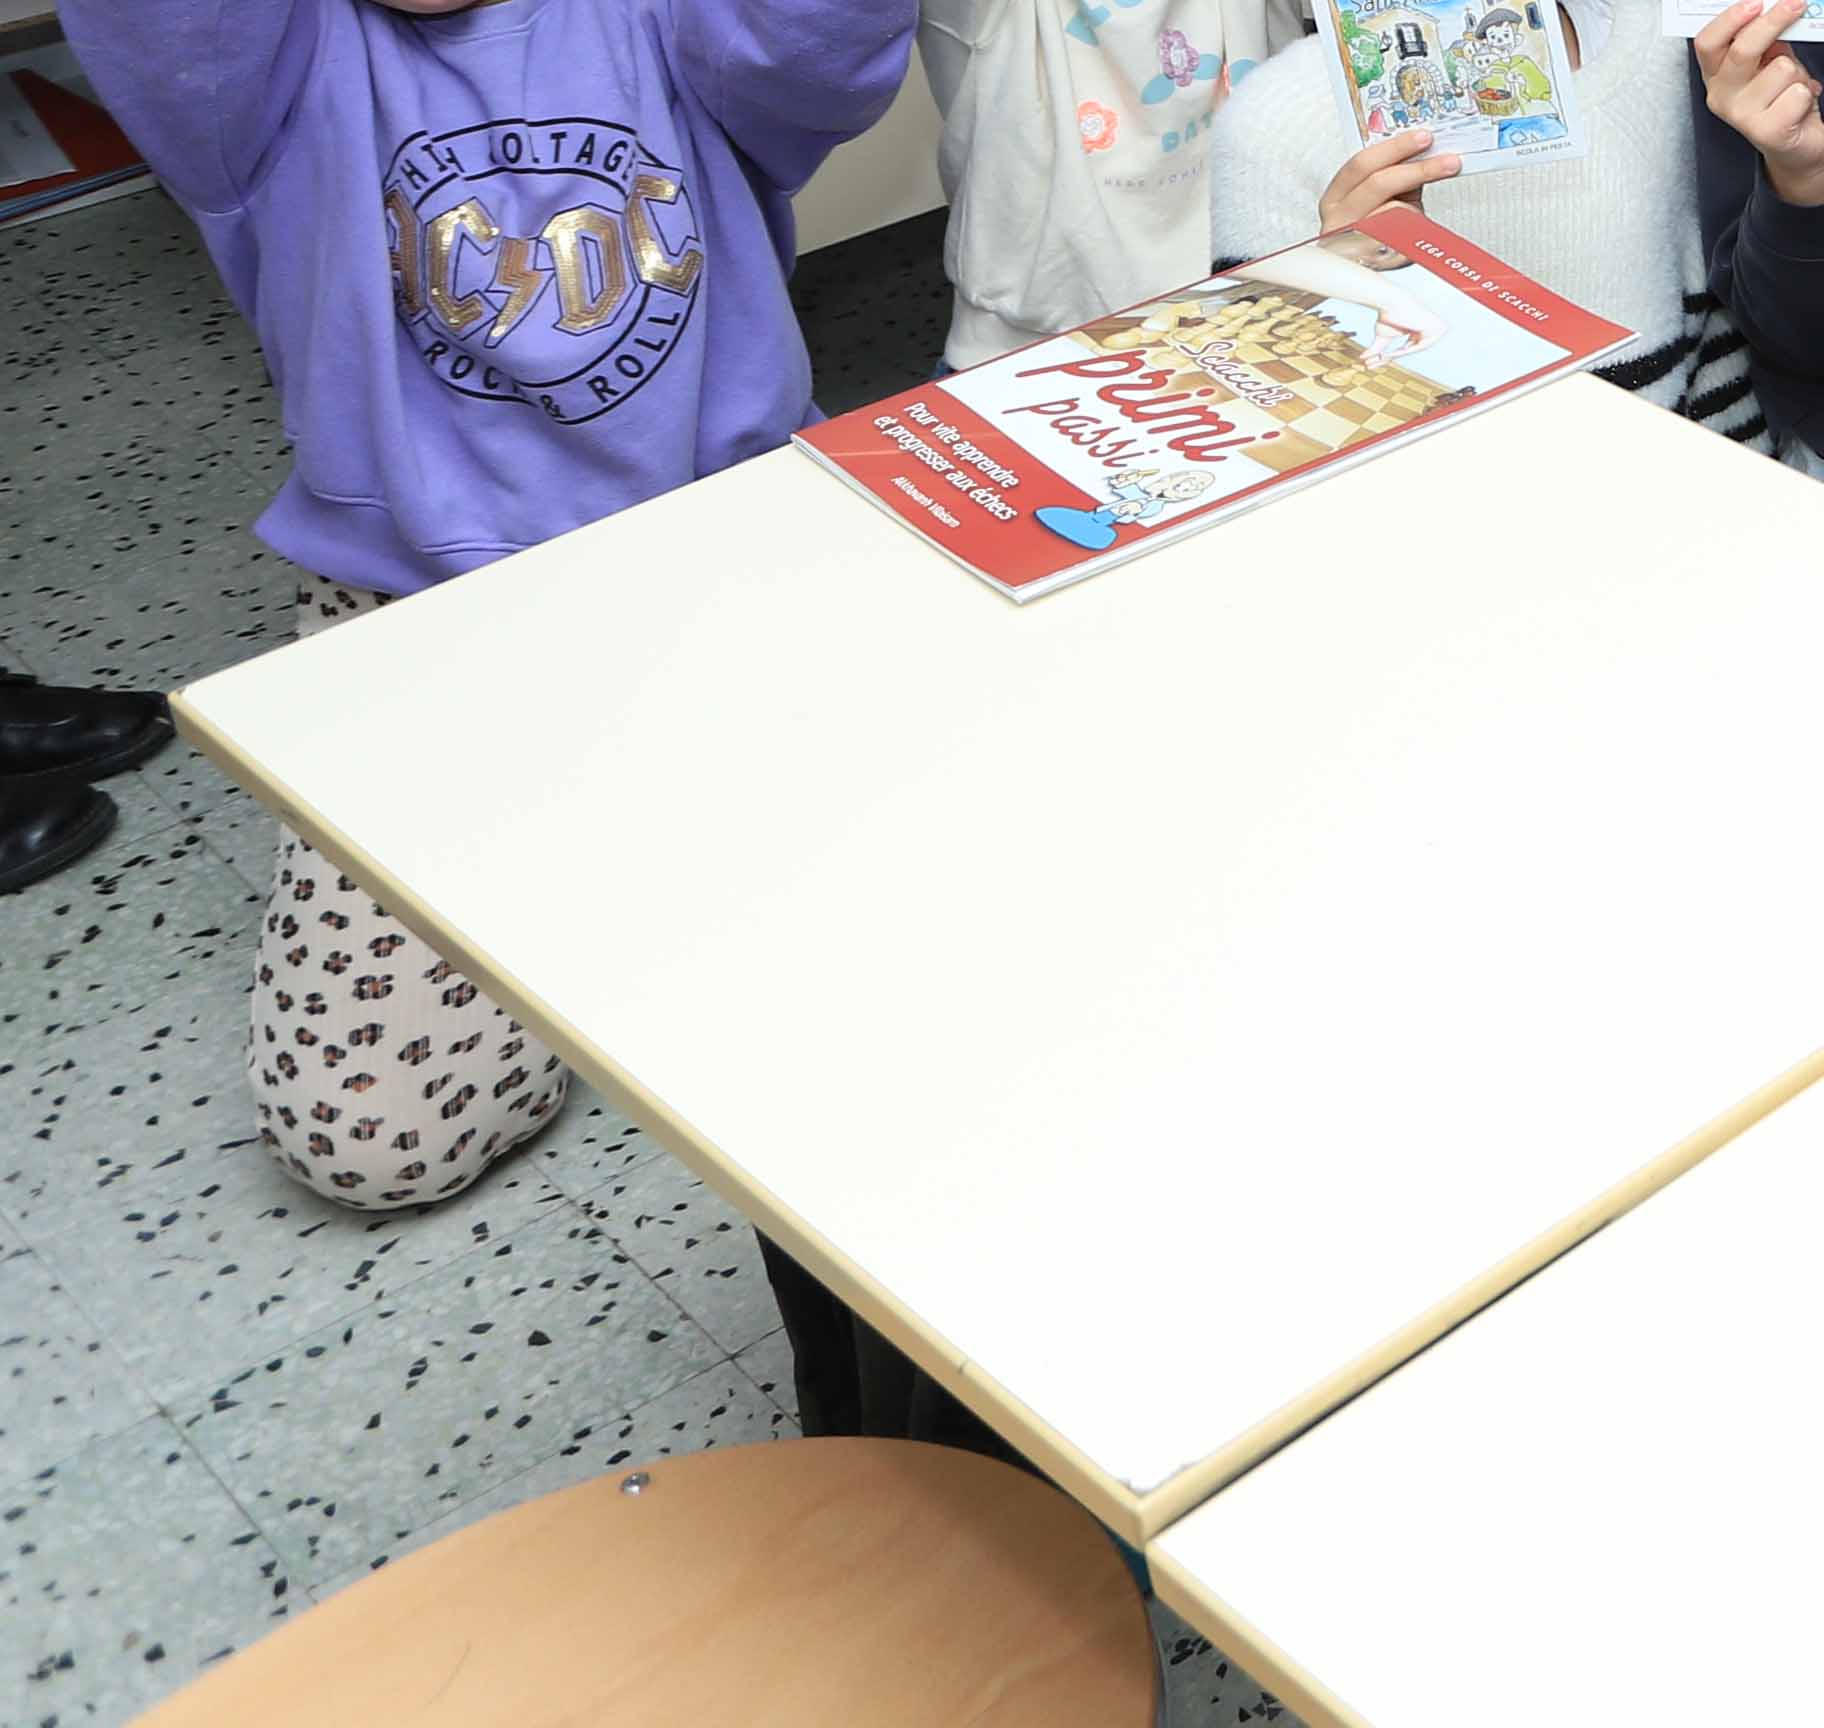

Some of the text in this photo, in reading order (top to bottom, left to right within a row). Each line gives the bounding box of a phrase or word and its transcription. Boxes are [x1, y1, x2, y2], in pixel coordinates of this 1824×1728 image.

[1415, 239, 1550, 322] LEGA CORSA DI SCACCHI
[586, 311, 682, 404] ROLL
[1177, 338, 1299, 408] Scacchi
[903, 401, 1020, 488] Pour vite apprendre
[1001, 395, 1150, 471] passi
[1016, 345, 1281, 465] primi
[873, 415, 1018, 521] et progresser aux échecs
